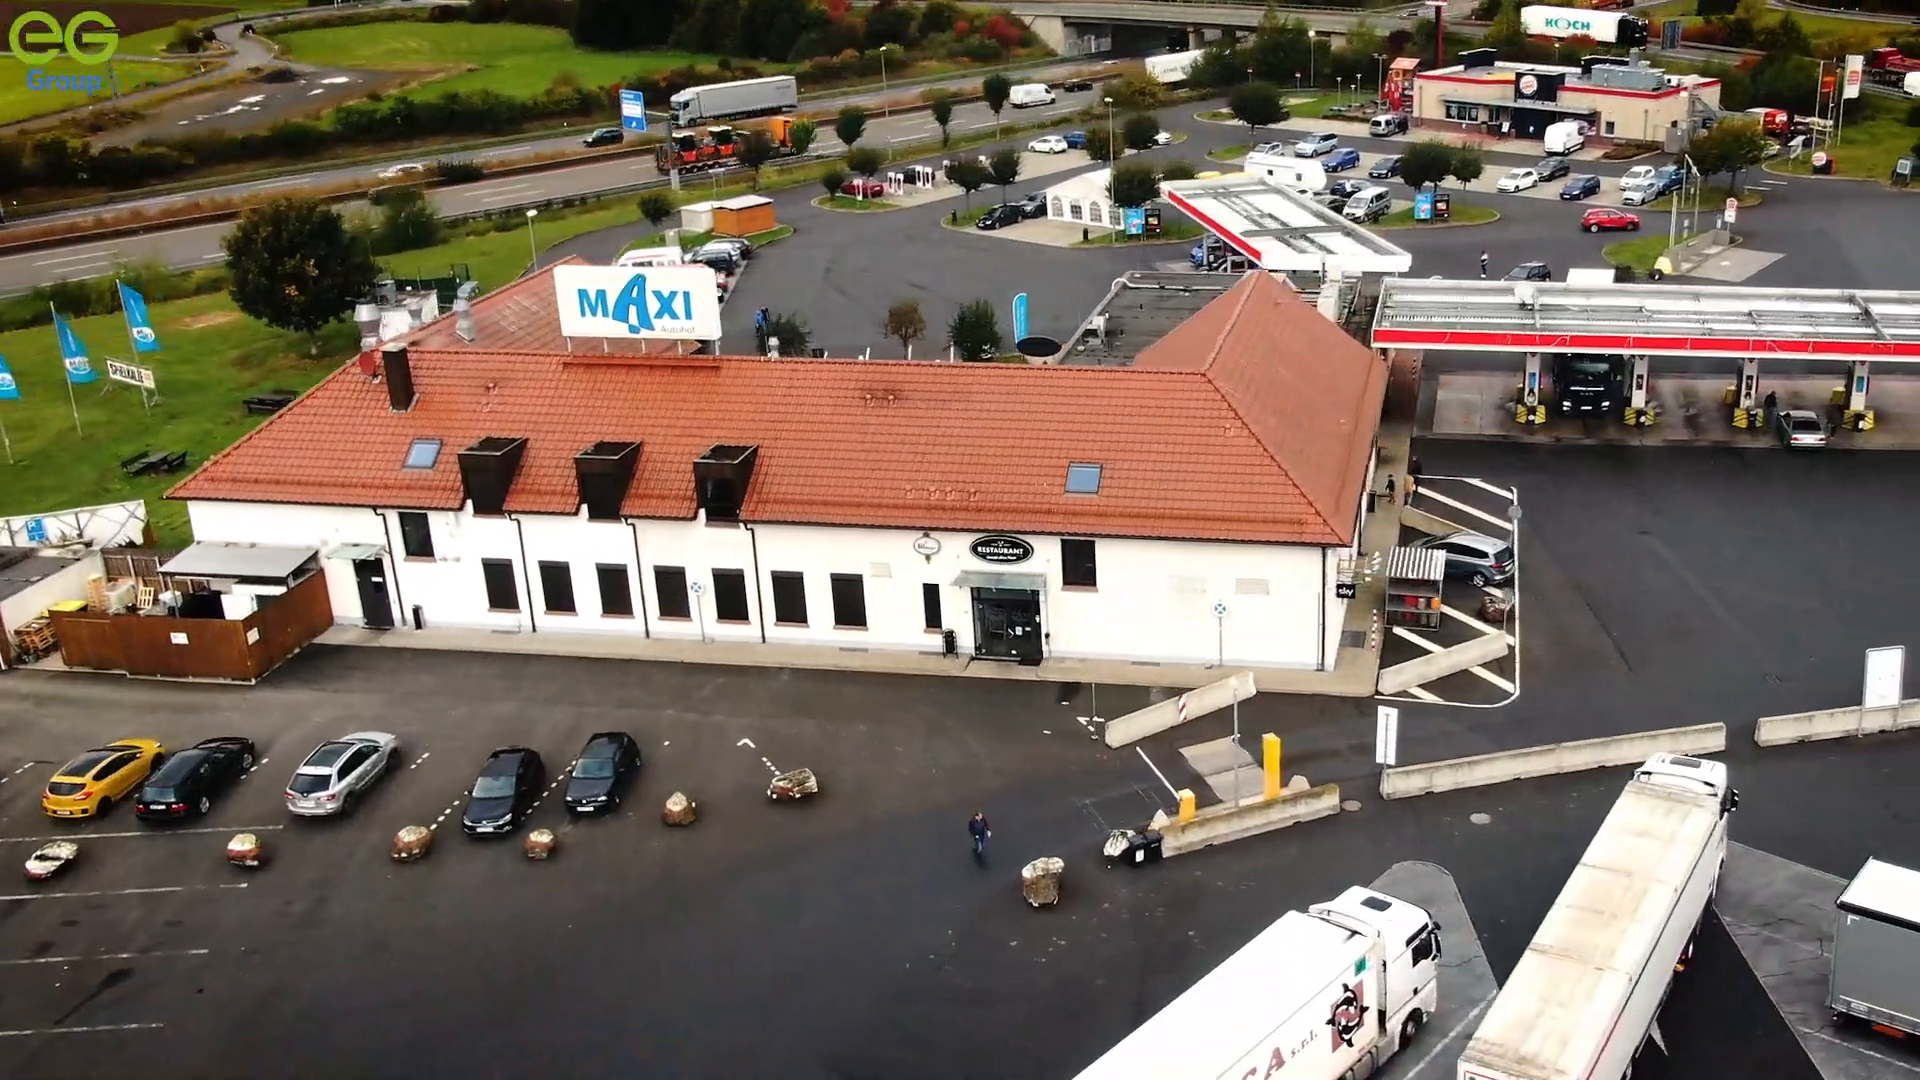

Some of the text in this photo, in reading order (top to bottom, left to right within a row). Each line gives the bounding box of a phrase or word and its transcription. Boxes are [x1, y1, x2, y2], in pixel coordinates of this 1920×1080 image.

[1545, 17, 1591, 31] KOCH
[577, 273, 693, 334] MAXI
[977, 546, 1024, 555] RESTAURANT
[1338, 587, 1354, 596] sky
